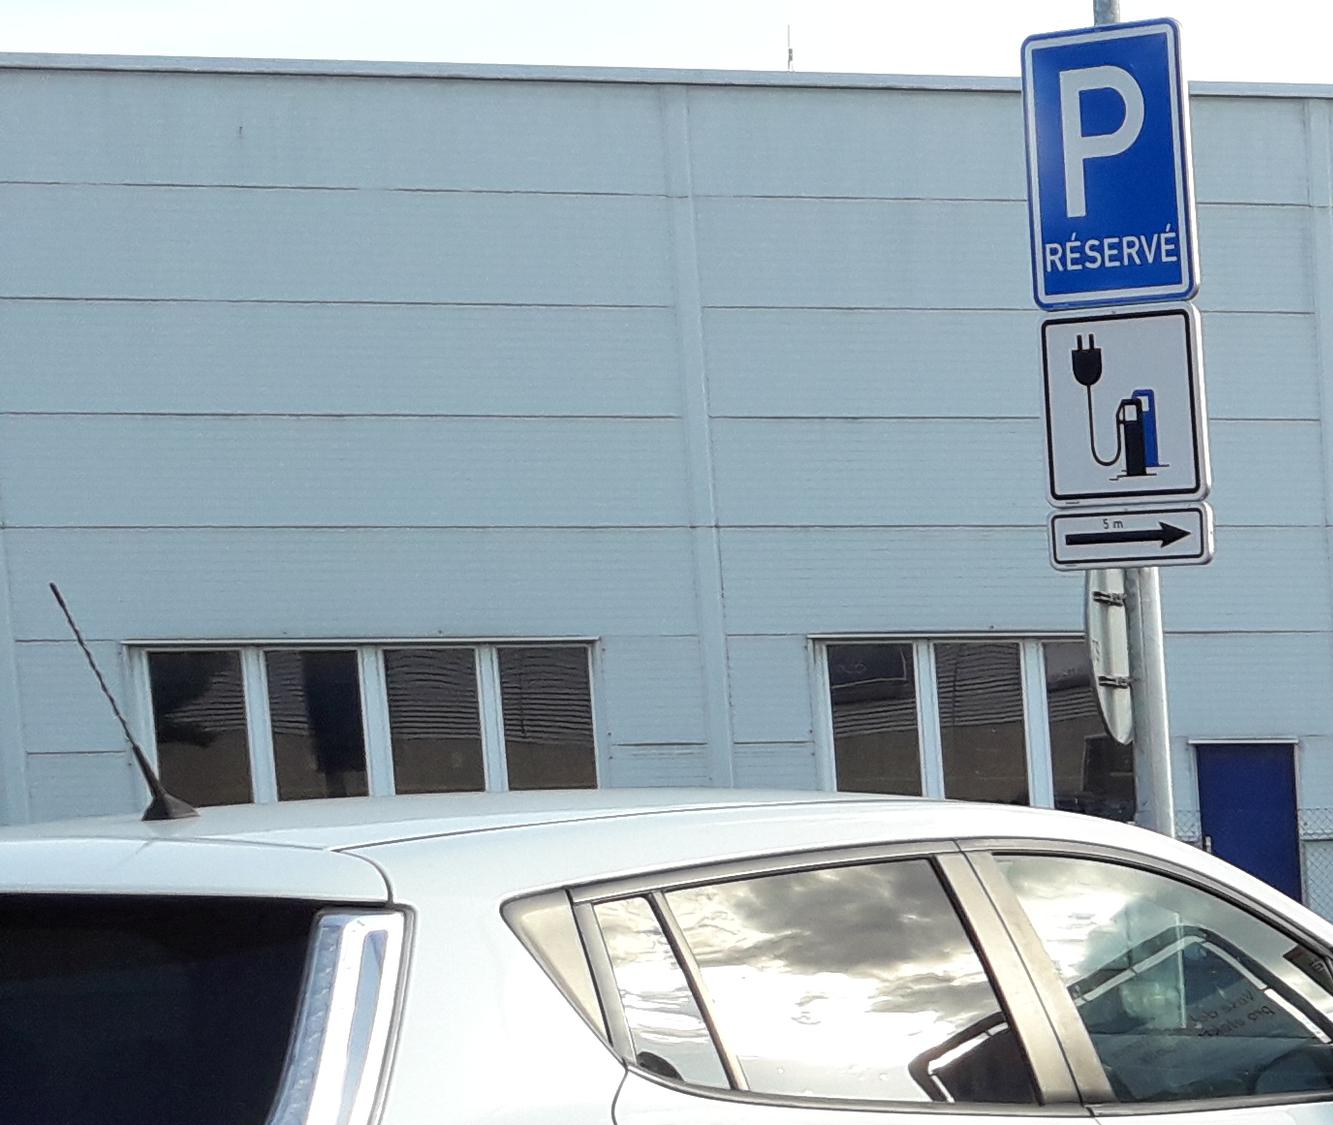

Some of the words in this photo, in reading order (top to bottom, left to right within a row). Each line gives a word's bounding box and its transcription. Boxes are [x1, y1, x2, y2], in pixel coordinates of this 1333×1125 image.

[1059, 64, 1145, 219] P
[1045, 223, 1178, 273] RÉSERVÉ
[1103, 518, 1110, 530] 5
[1113, 520, 1124, 529] m
